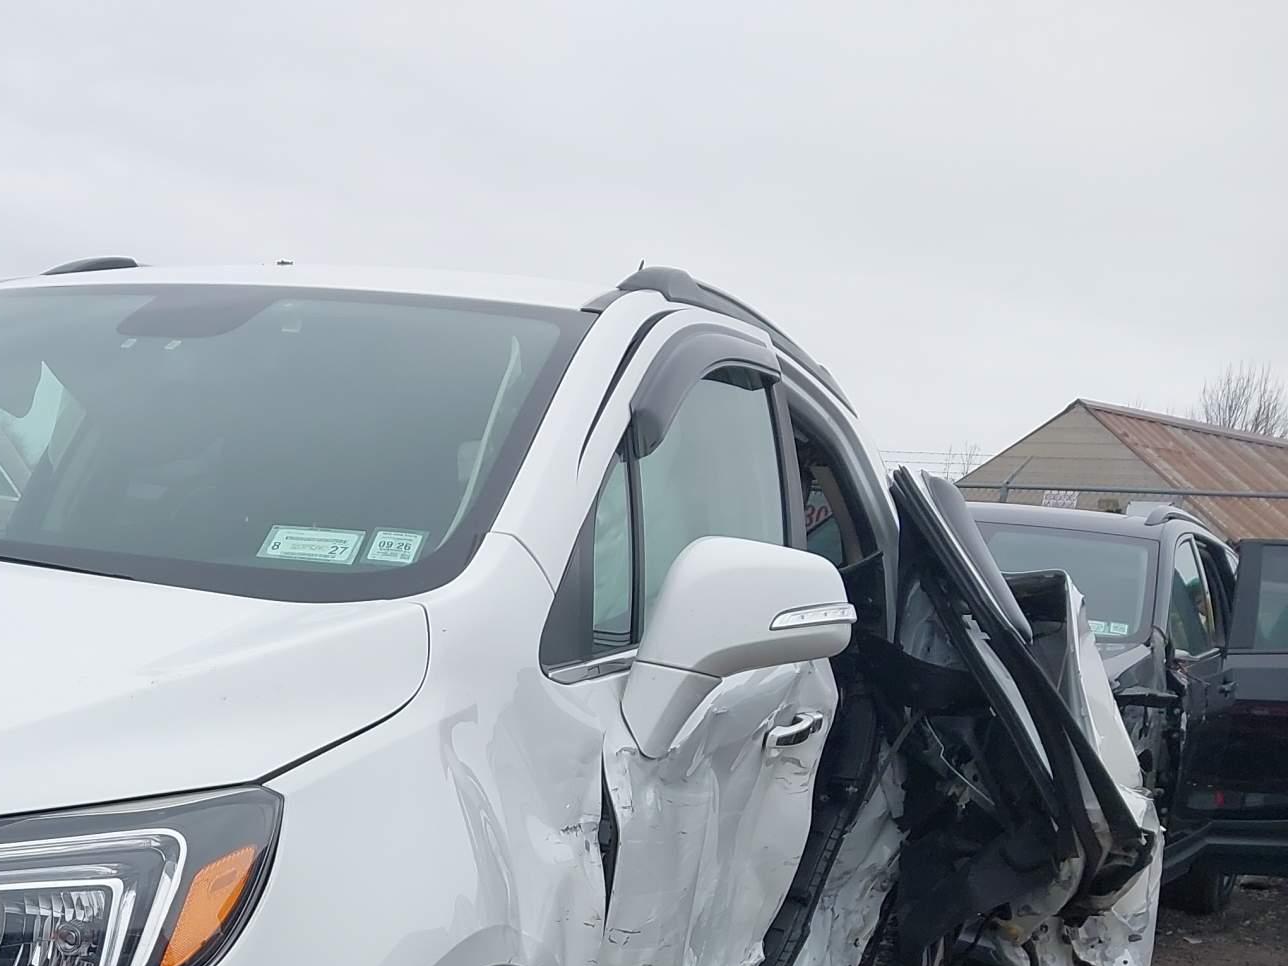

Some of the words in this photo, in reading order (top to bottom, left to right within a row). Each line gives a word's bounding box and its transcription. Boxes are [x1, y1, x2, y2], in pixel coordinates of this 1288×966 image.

[271, 541, 281, 551] 8
[328, 545, 349, 555] 27
[378, 540, 394, 549] 09
[396, 542, 412, 551] 26
